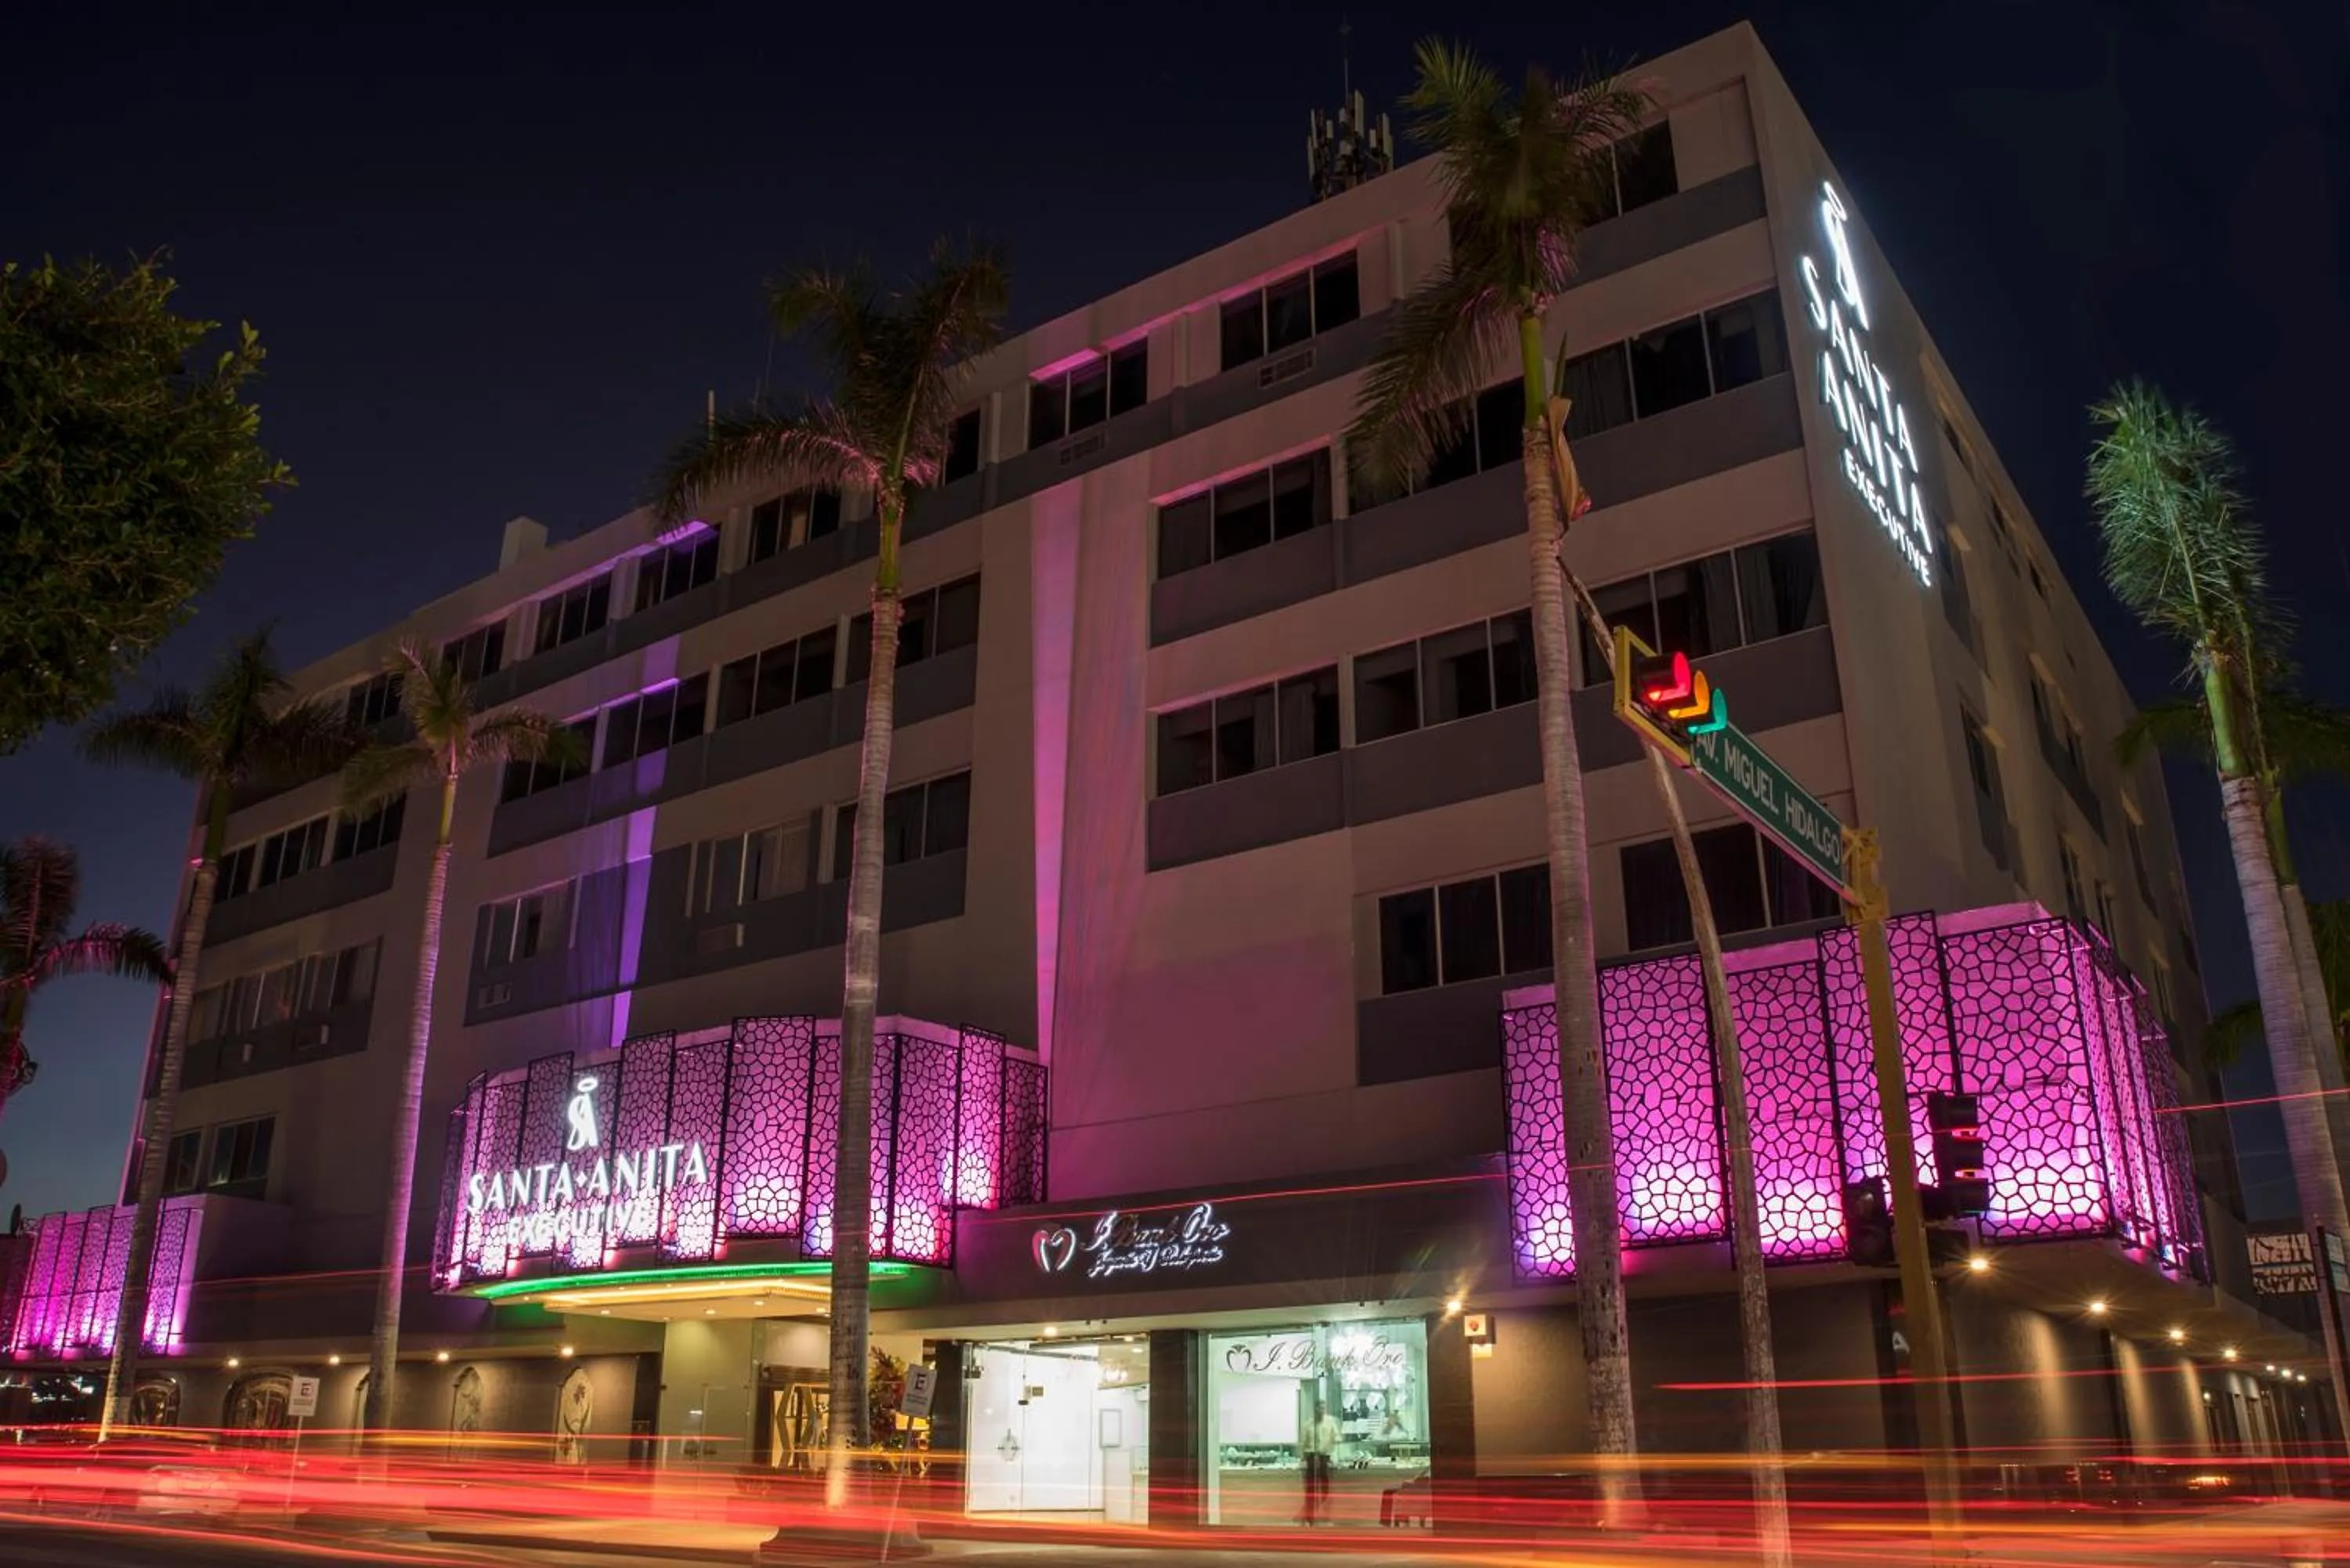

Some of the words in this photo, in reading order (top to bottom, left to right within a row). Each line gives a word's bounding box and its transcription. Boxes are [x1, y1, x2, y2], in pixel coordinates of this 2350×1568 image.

[1801, 255, 1918, 473] SANTA
[1824, 351, 1932, 555] ANITA
[1842, 447, 1932, 587] EXECUTIVE
[1723, 738, 1779, 815] MIGUEL
[1784, 791, 1841, 865] HIDALGO
[466, 1160, 574, 1213] SANTA
[586, 1138, 708, 1198] ANITA
[507, 1198, 658, 1245] EXECUTIVE
